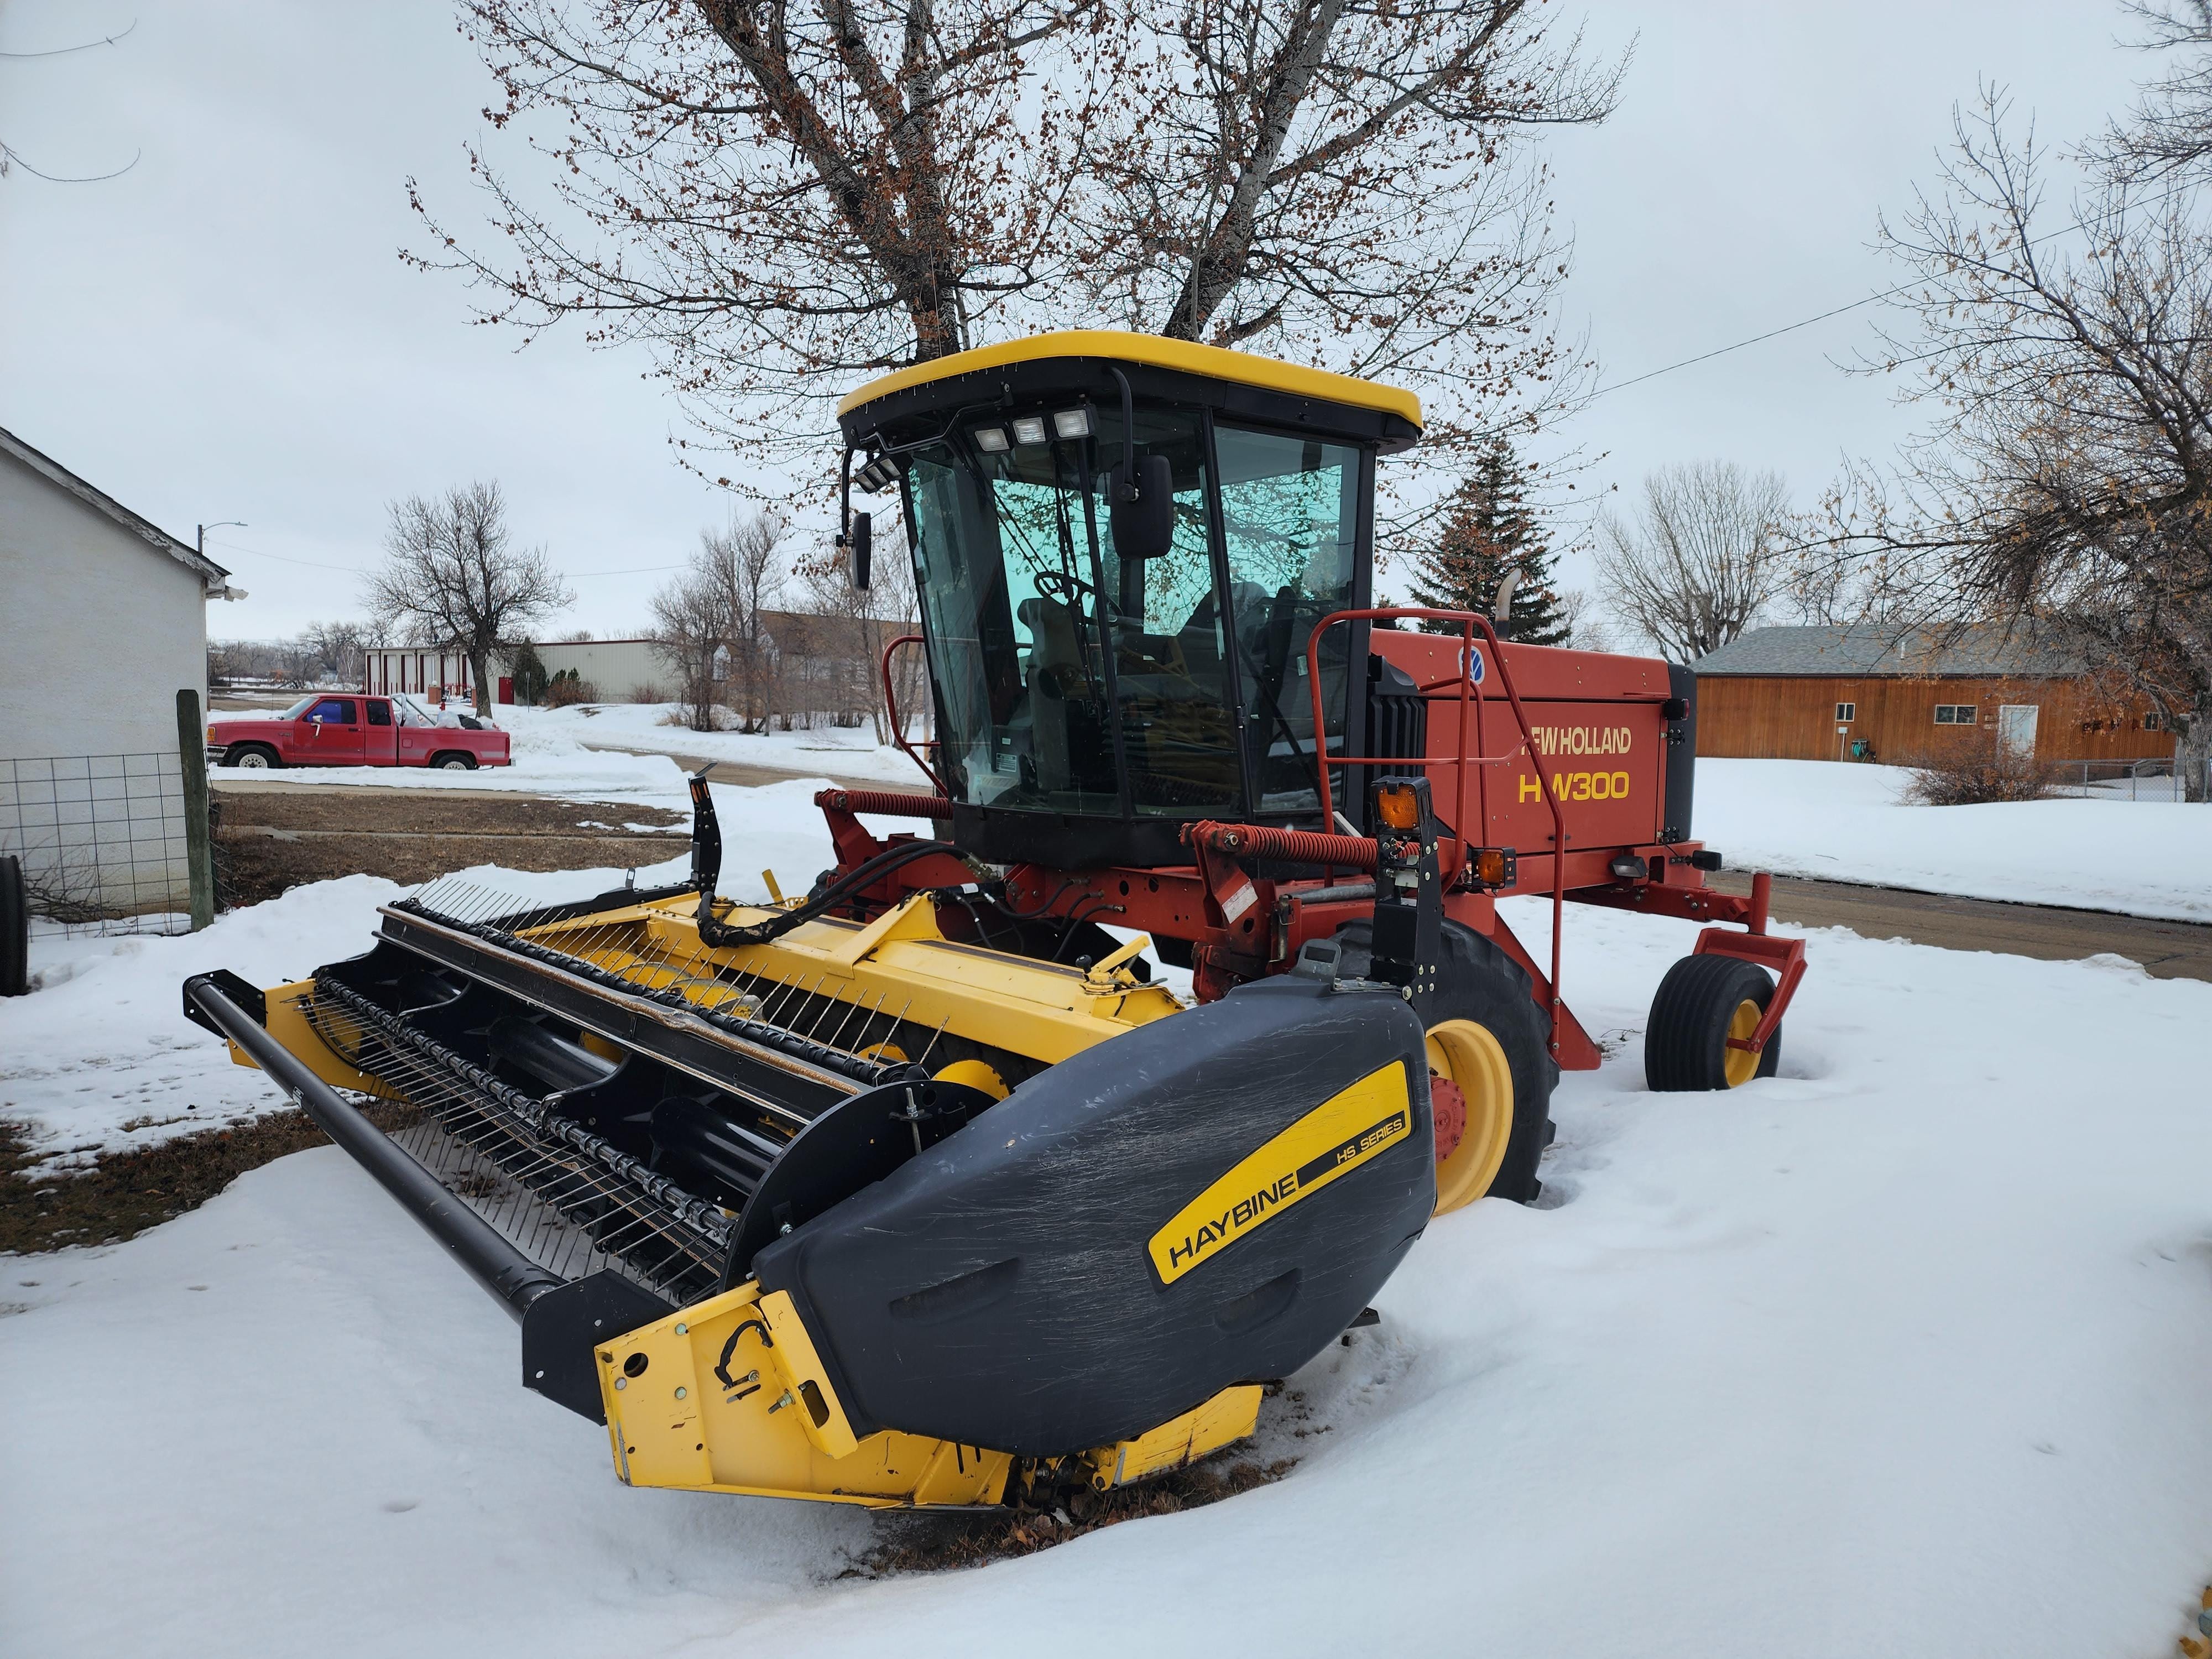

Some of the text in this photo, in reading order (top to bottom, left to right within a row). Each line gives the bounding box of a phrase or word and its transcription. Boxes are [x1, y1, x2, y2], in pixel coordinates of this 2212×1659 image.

[1559, 726, 1631, 755] HOLLAND
[1519, 772, 1630, 803] HW300
[1169, 1118, 1402, 1269] HAYBINE HS SERIES
